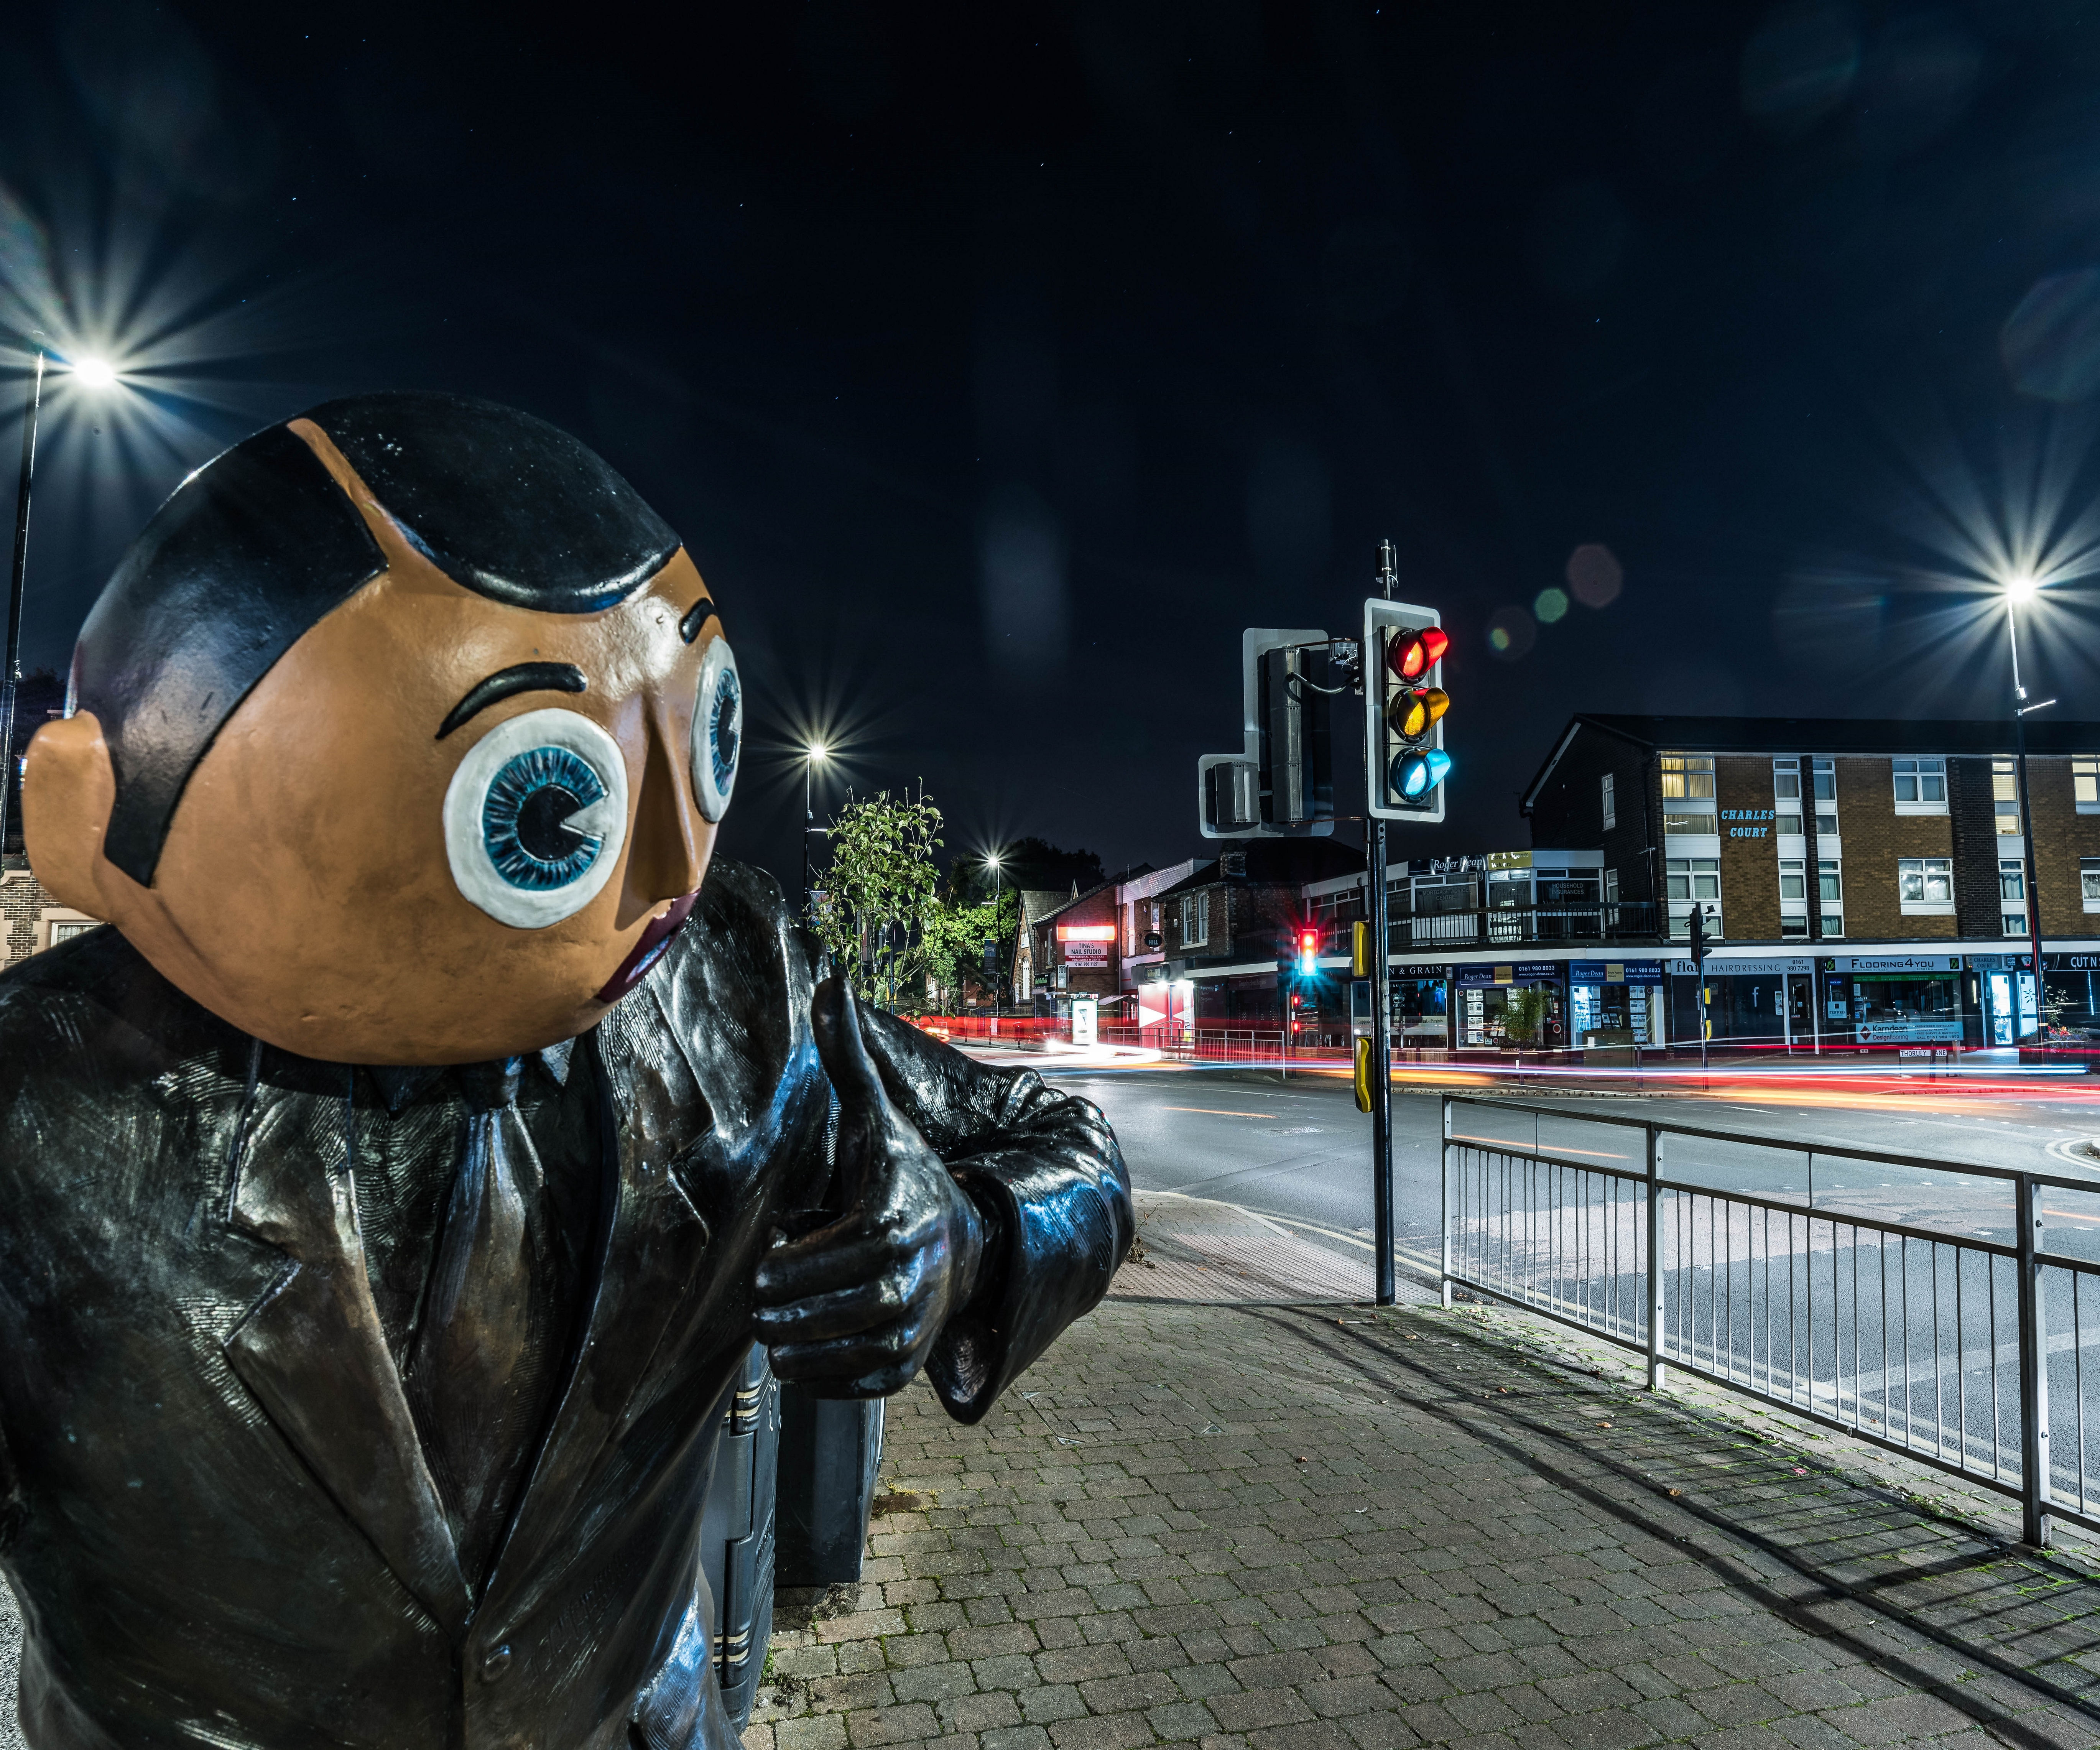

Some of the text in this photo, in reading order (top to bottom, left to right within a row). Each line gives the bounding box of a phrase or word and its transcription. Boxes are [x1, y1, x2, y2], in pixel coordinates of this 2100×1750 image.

[1721, 810, 1774, 820] CHARLES
[1730, 827, 1768, 837] COURT
[1434, 857, 1482, 872] Roger Dean
[1676, 961, 1781, 972] flai HAIRDRESSING
[2070, 957, 2088, 967] CUT
[2090, 957, 2097, 967] N
[1410, 966, 1442, 974] GRAIN
[1872, 1025, 1908, 1033] Karndean
